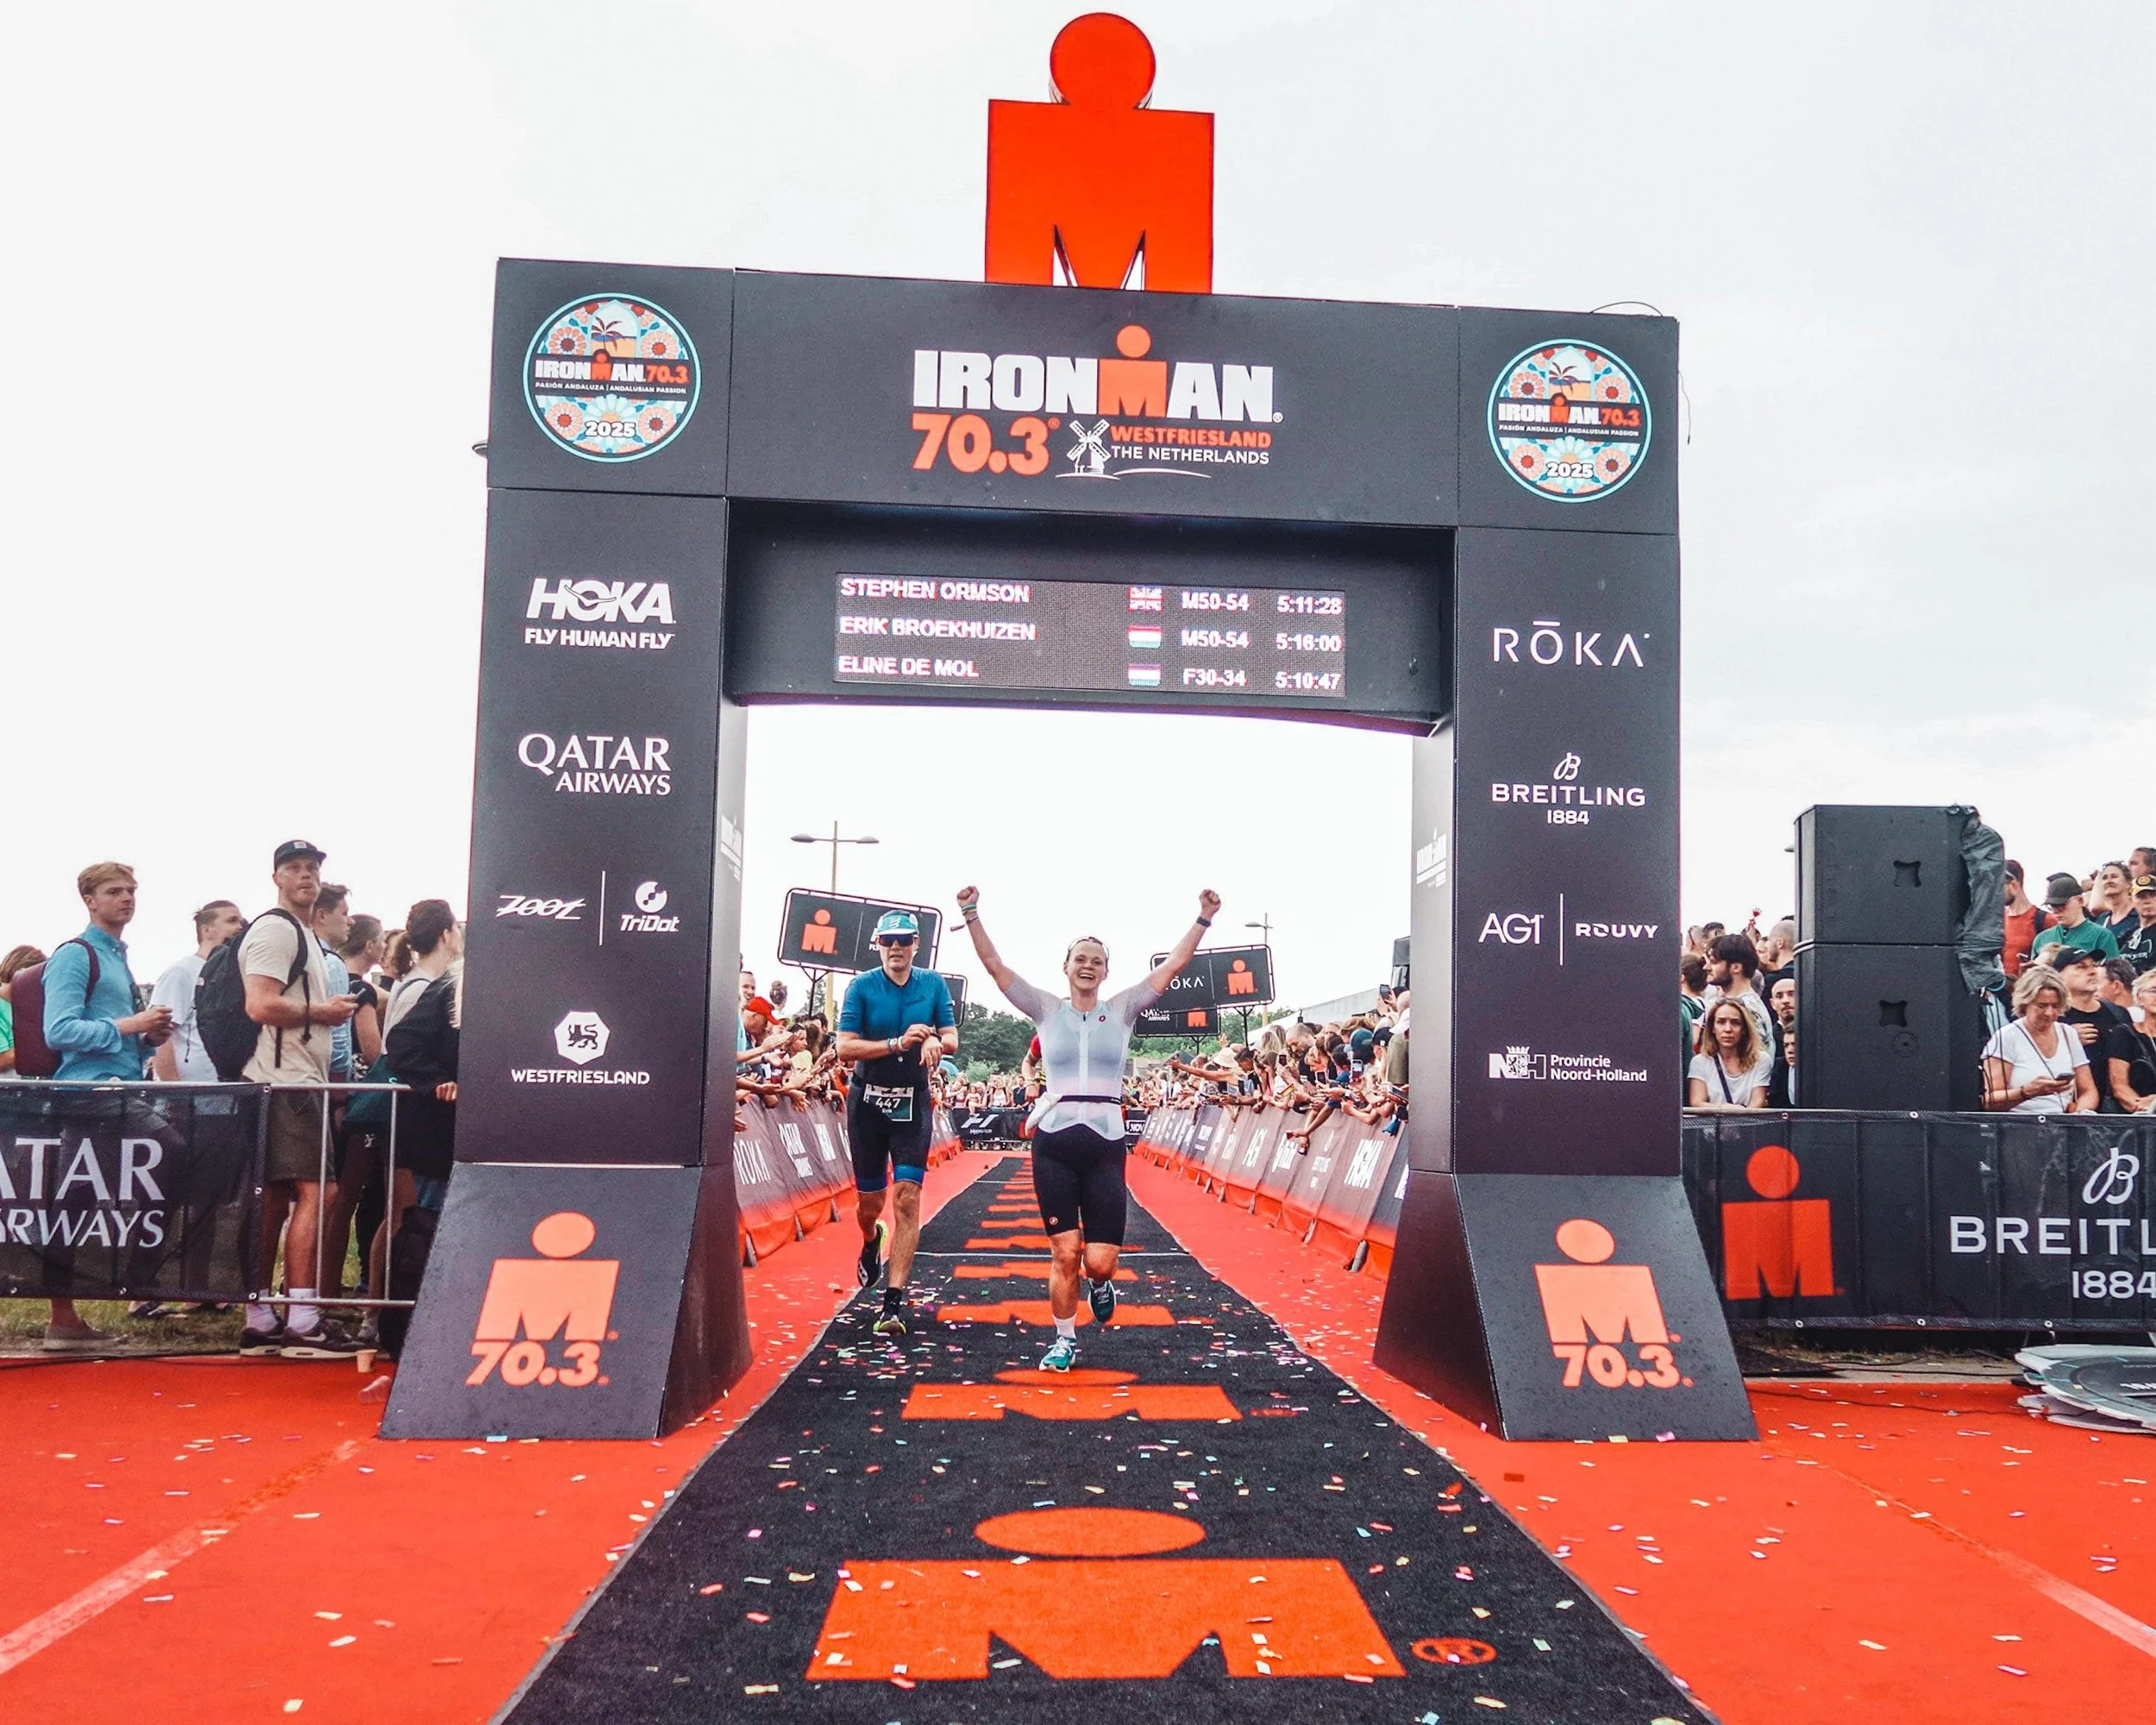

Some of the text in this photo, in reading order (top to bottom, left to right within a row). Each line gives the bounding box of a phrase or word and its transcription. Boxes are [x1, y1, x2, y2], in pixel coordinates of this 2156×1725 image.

[535, 352, 688, 384] IRONMAN 70.3
[912, 325, 1274, 423] IRONMAN
[1498, 397, 1641, 427] IRONMAN 70.3
[584, 421, 636, 438] 2025
[1111, 425, 1272, 448] WESTFRIESLAND
[912, 413, 1050, 475] 70.3
[1111, 445, 1270, 465] THE NETHERLANDS
[1546, 462, 1595, 478] 2025
[526, 578, 674, 624] HOKA
[841, 579, 1343, 614] STEPHEN ORMSON M50-54 5:11:28
[524, 628, 673, 649] FLY HUMAN FLY
[839, 617, 1343, 651] ERIK BROEKHUIZEN M50-54 5:16:00
[838, 656, 1341, 689] ELINE DE MOL F30-34 5:10:47
[518, 733, 671, 776] QATAR
[555, 771, 672, 795] AIRWAYS
[1492, 783, 1646, 806] BREITLING
[1547, 810, 1589, 825] 1884
[620, 914, 680, 932] TriDot
[1478, 913, 1658, 944] AG1 ROUVY
[1551, 1054, 1611, 1067] Provincie
[511, 1069, 650, 1085] WESTFRIESLAND
[1551, 1068, 1647, 1082] Noord-Holland
[875, 1097, 900, 1108] 447
[2072, 1270, 2156, 1299] 1884
[464, 1341, 601, 1387] 70.3
[1552, 1344, 1681, 1389] 70.3
